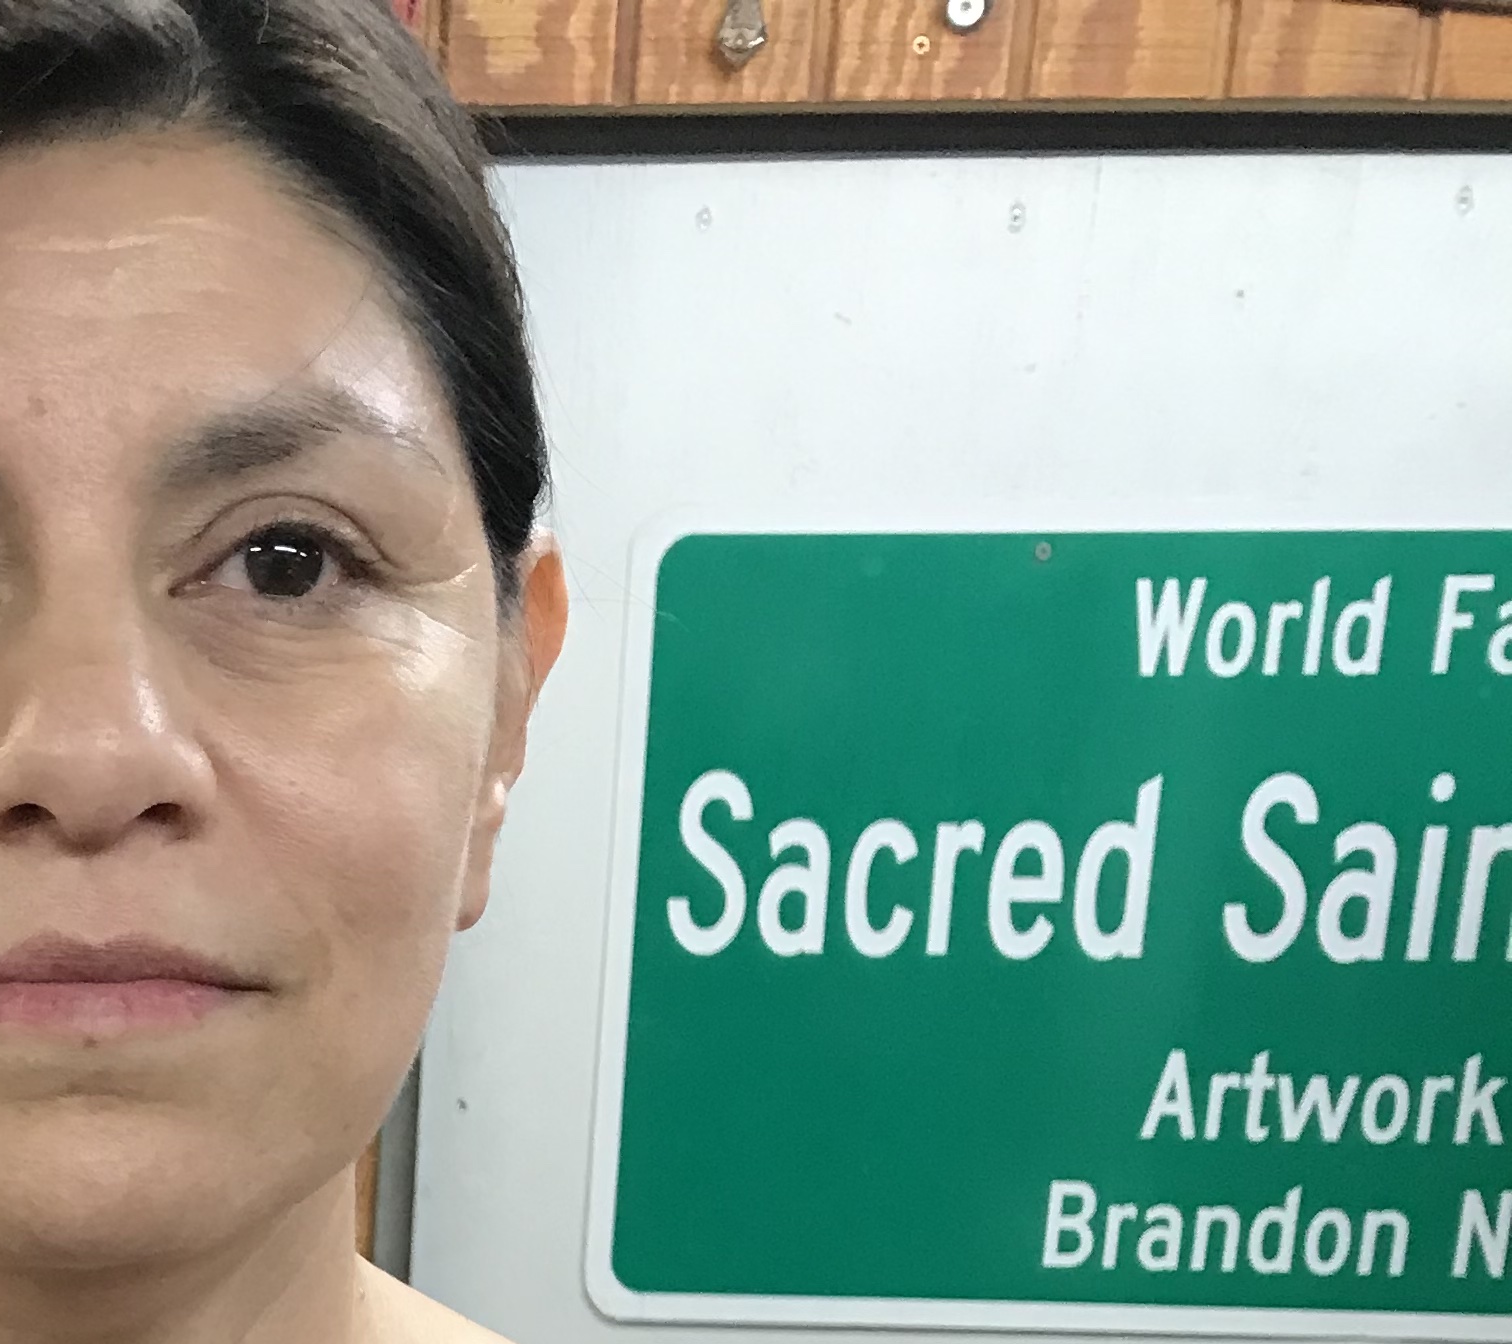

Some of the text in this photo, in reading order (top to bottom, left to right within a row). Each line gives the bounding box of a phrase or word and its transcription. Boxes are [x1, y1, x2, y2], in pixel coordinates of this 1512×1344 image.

[1135, 574, 1393, 678] World
[666, 769, 1512, 966] Sacred Sain
[1140, 1048, 1508, 1144] Artwork
[1040, 1180, 1512, 1279] Brandon N
